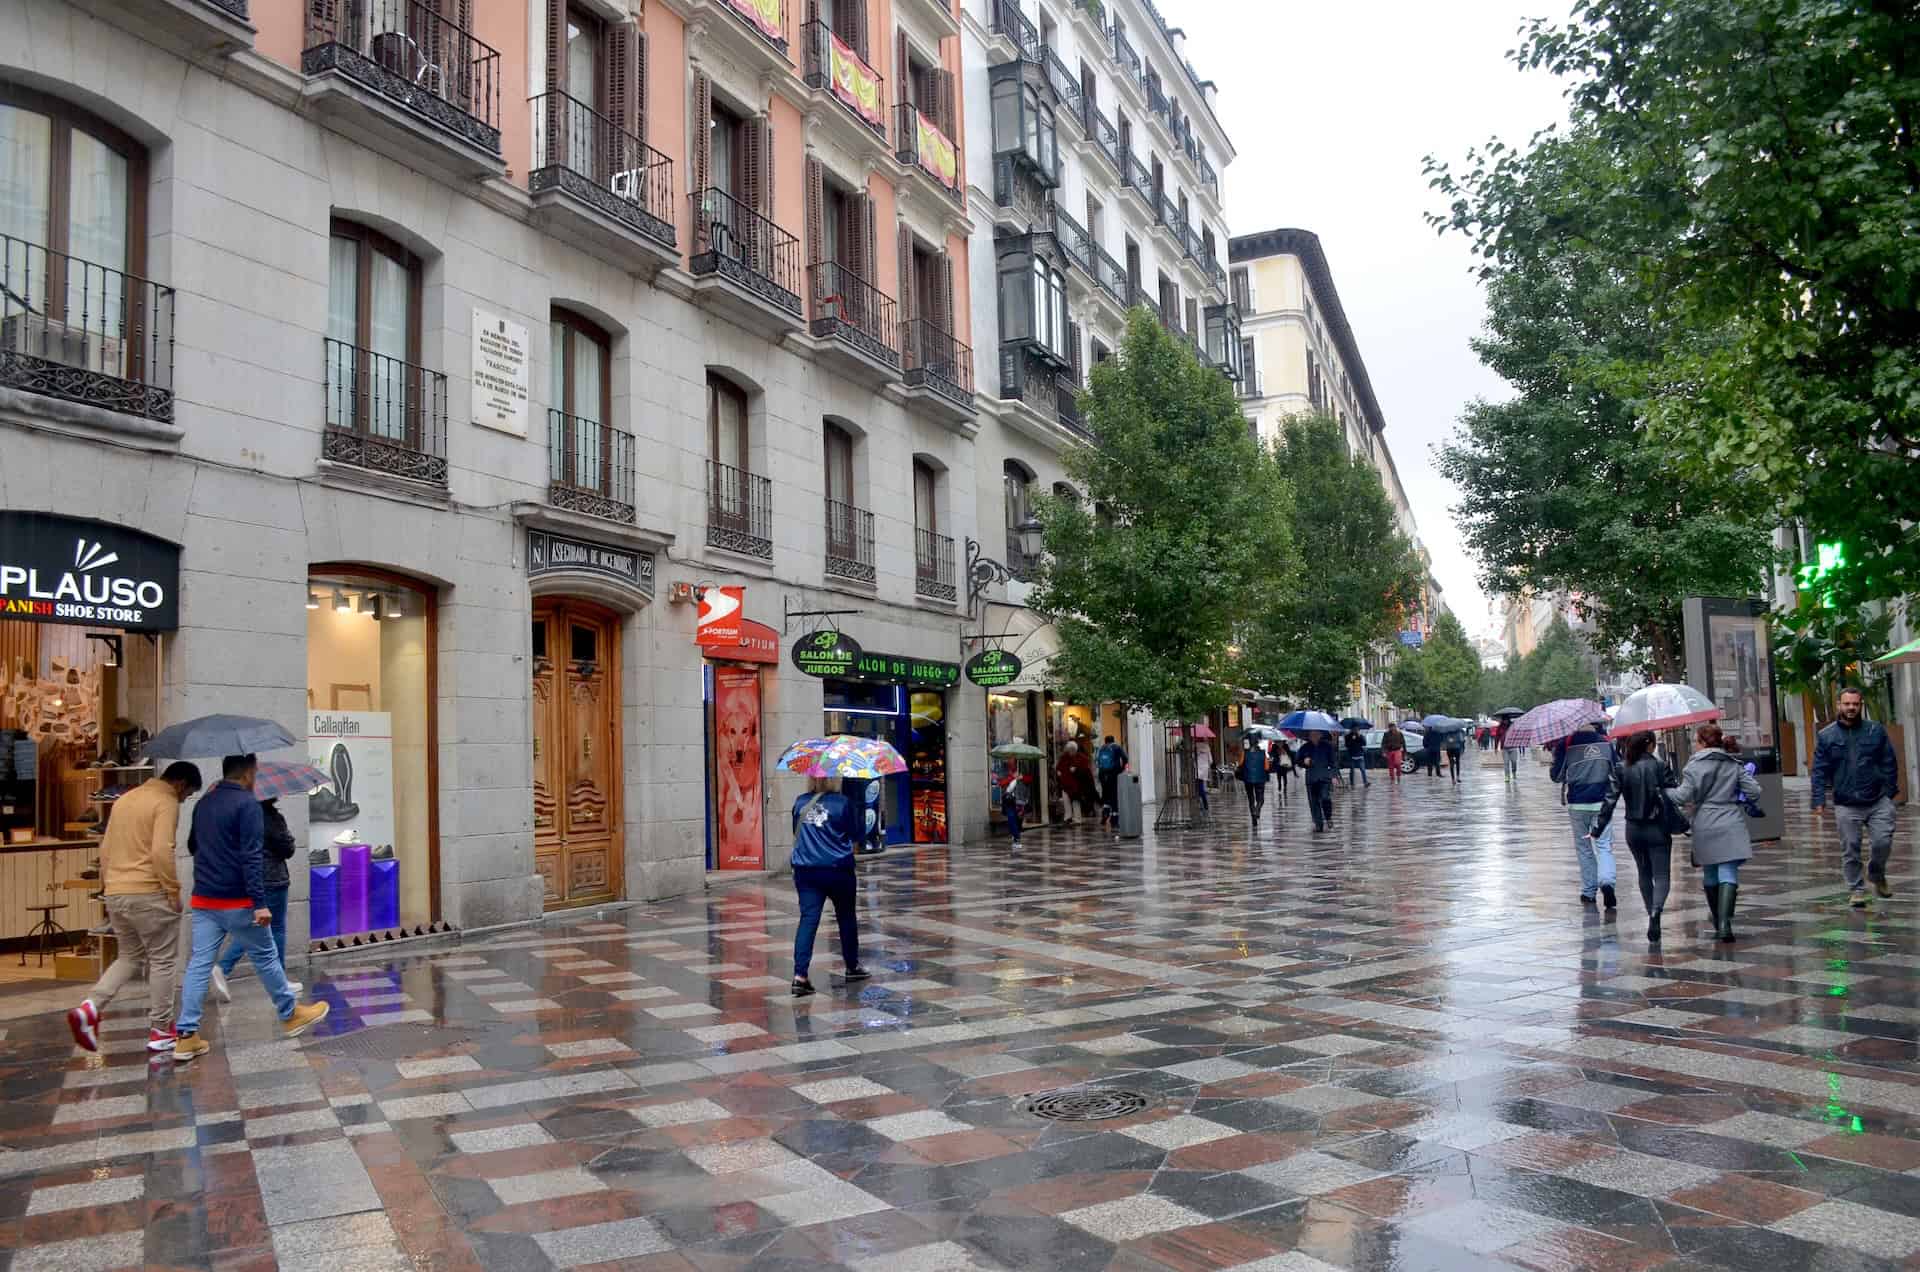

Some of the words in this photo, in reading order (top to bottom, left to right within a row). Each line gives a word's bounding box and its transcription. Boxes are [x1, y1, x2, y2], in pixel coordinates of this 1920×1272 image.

[641, 560, 652, 577] 22
[56, 603, 95, 619] SHOE
[97, 606, 144, 623] STORE
[800, 650, 834, 660] SALON
[837, 651, 853, 660] DE
[805, 665, 846, 674] JUEGOS
[892, 662, 906, 675] DE
[977, 676, 1009, 685] JUEGOS
